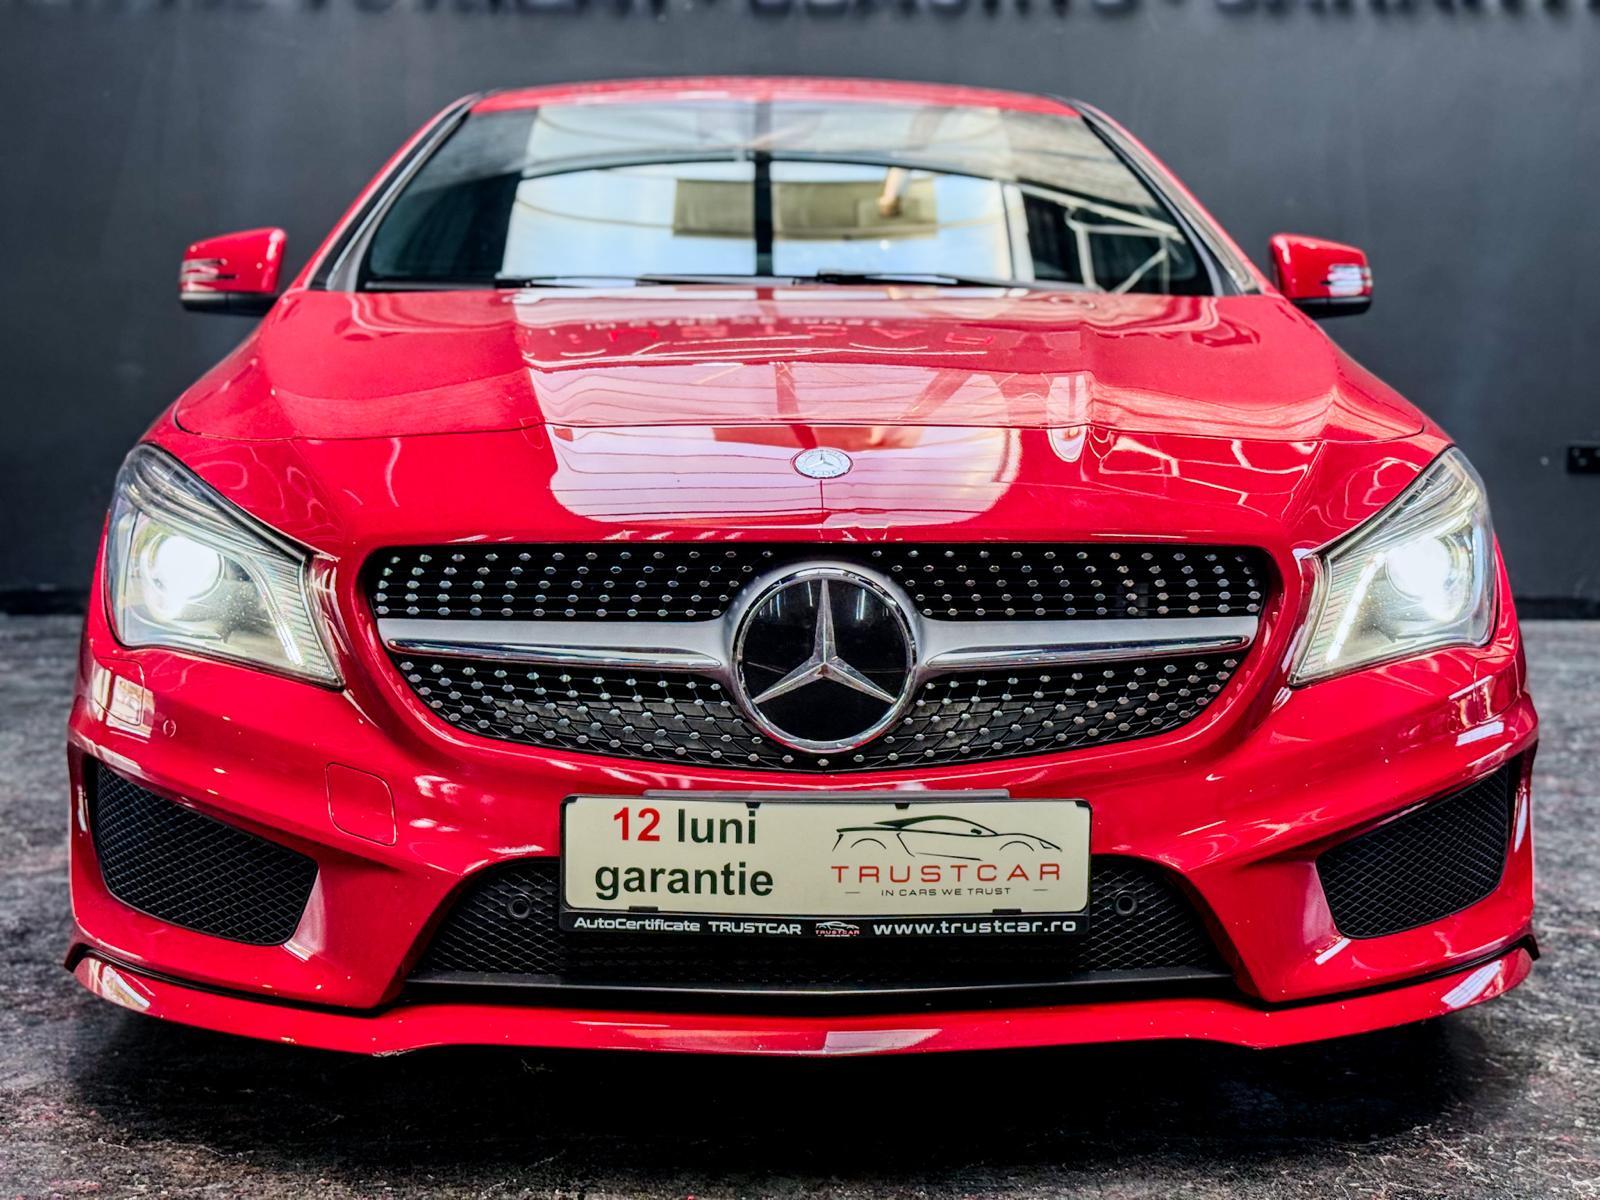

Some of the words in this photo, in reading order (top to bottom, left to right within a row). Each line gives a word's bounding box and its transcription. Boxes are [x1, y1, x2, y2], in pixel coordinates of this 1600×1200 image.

[613, 806, 661, 842] 12
[677, 808, 756, 844] luni
[595, 861, 774, 901] garantie
[830, 863, 1061, 883] TRUSTCAR
[881, 889, 894, 897] IN
[898, 888, 938, 896] CARS
[941, 888, 962, 896] WE
[967, 887, 1012, 896] TRUST
[573, 916, 701, 932] AutoCertificate
[707, 921, 802, 935] TRUSTCAR
[873, 919, 1077, 936] www.trustcar.ro
